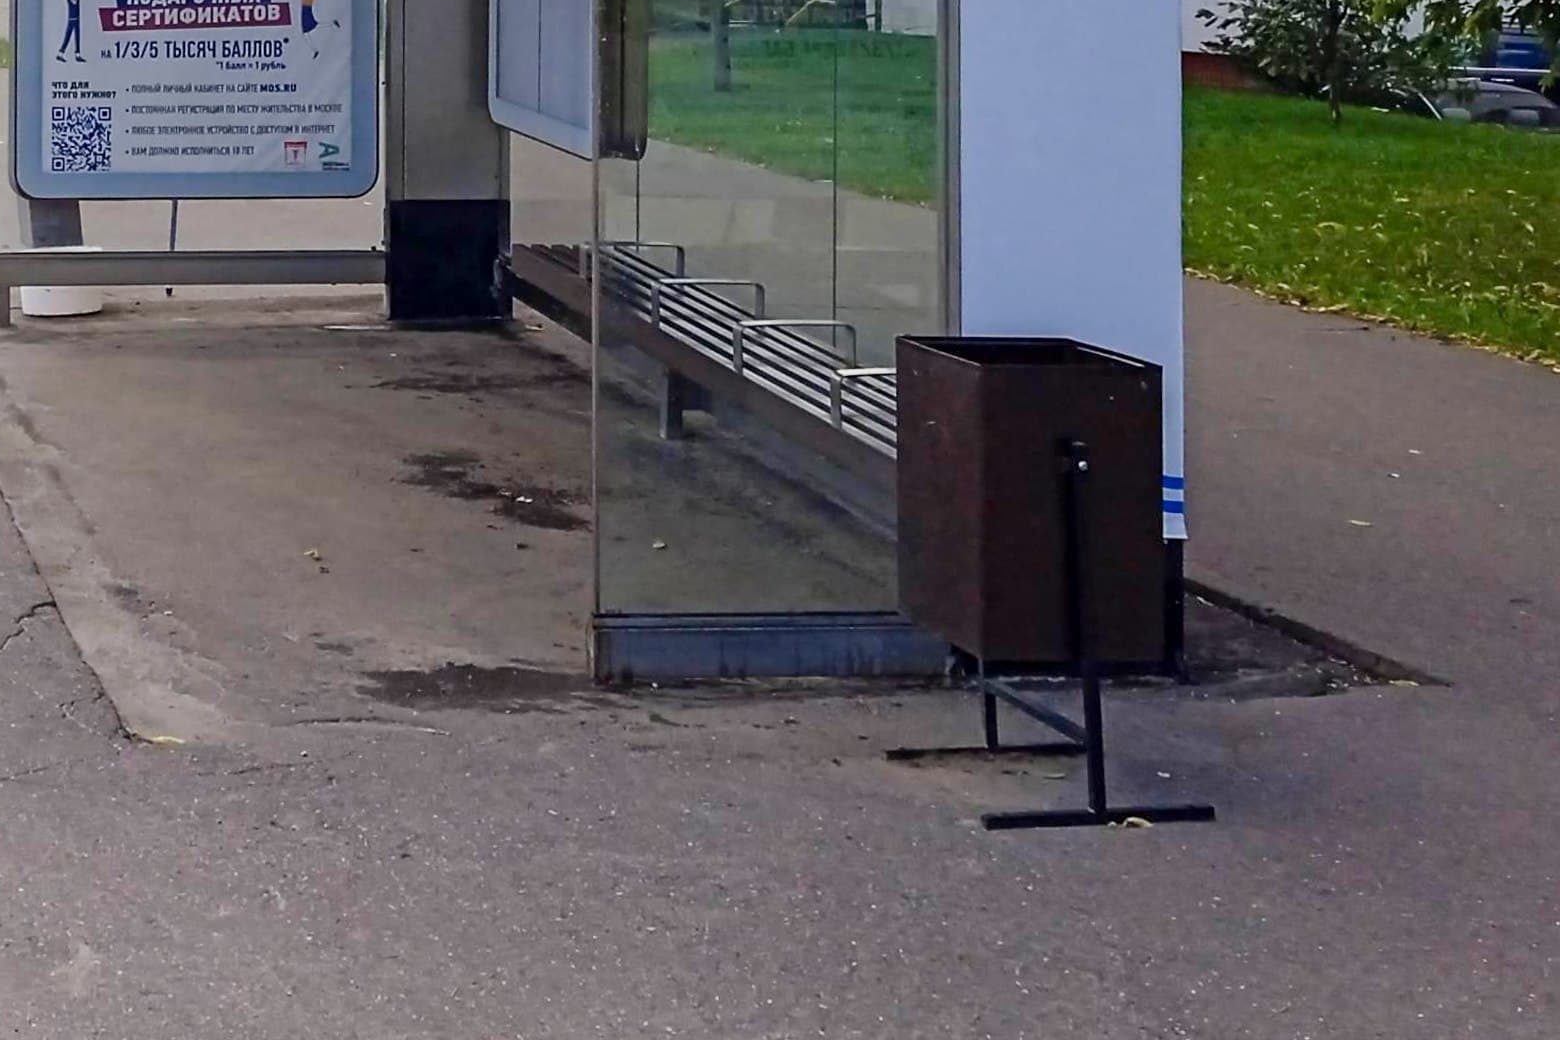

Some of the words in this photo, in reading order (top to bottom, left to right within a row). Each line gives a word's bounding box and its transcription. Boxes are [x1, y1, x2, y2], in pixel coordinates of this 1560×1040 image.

[111, 3, 282, 28] СЕРТИФИКАТОВ
[100, 49, 112, 58] НА
[114, 40, 159, 59] 1/3/5
[163, 40, 217, 59] ТЫСЯЧ
[260, 61, 287, 72] рубль
[51, 81, 68, 90] ЧТО
[70, 81, 89, 90] ДЛЯ
[226, 84, 236, 92] НА
[237, 82, 257, 93] САЙТЕ
[259, 83, 297, 93] MOS.RU
[51, 91, 78, 99] ЭТОГО
[80, 91, 117, 99] НУЖНО?
[237, 104, 258, 113] МЕСТУ
[301, 124, 336, 134] ИНТЕРНЕТ
